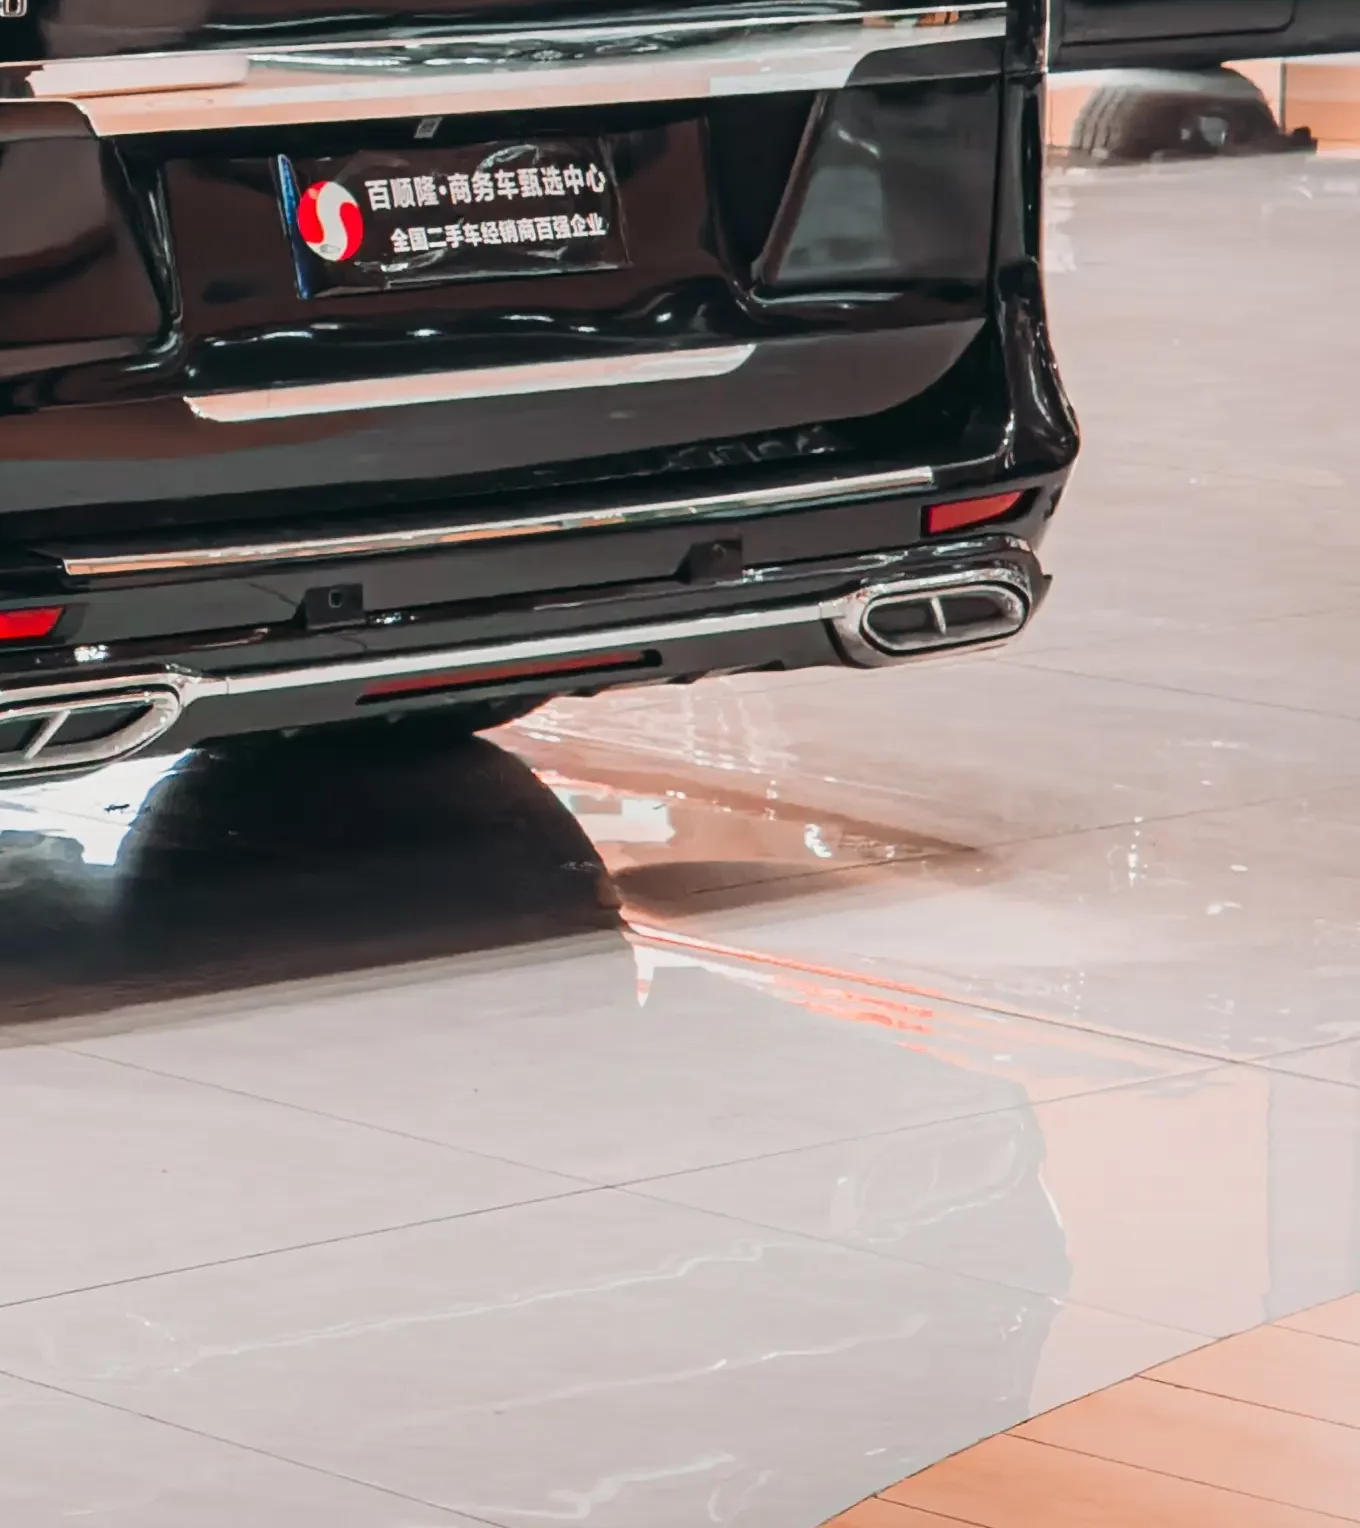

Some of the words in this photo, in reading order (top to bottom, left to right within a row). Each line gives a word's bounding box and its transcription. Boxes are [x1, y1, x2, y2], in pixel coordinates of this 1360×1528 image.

[389, 212, 607, 254] 全国二手车经销商百强企业
